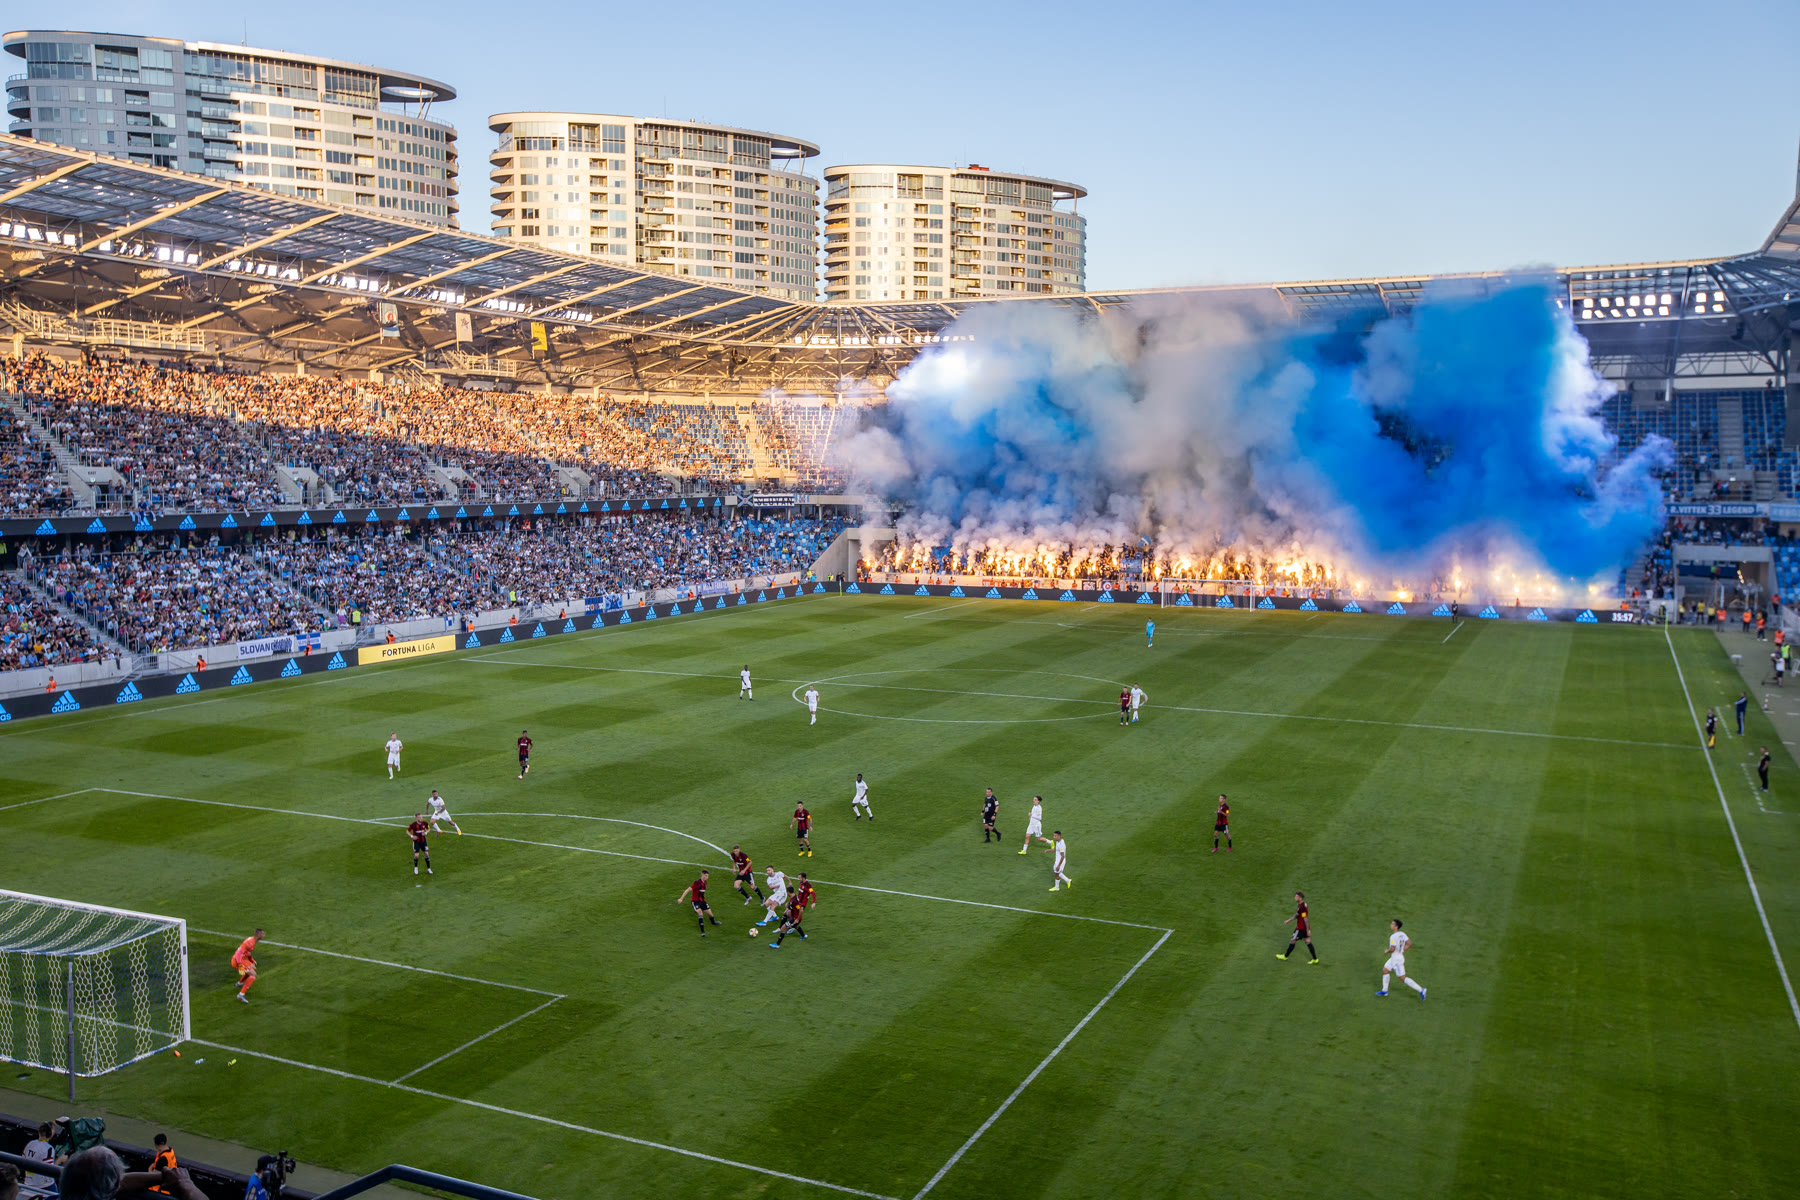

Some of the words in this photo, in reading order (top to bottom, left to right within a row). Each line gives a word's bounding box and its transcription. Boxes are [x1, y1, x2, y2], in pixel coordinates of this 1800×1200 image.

[1708, 505, 1721, 515] 33
[1723, 506, 1755, 514] LEGEND
[1612, 612, 1634, 622] 35:57
[532, 630, 546, 638] adidas
[563, 625, 576, 633] adidas
[465, 640, 481, 648] adidas
[500, 635, 514, 643] adidas
[240, 642, 270, 655] SLOVAN
[382, 646, 416, 657] FORTUNA
[418, 642, 435, 652] LIGA
[328, 661, 347, 670] adidas
[281, 668, 301, 677] adidas
[231, 675, 253, 685] adidas
[176, 684, 200, 694] adidas
[116, 692, 142, 703] adidas
[52, 702, 80, 713] adidas
